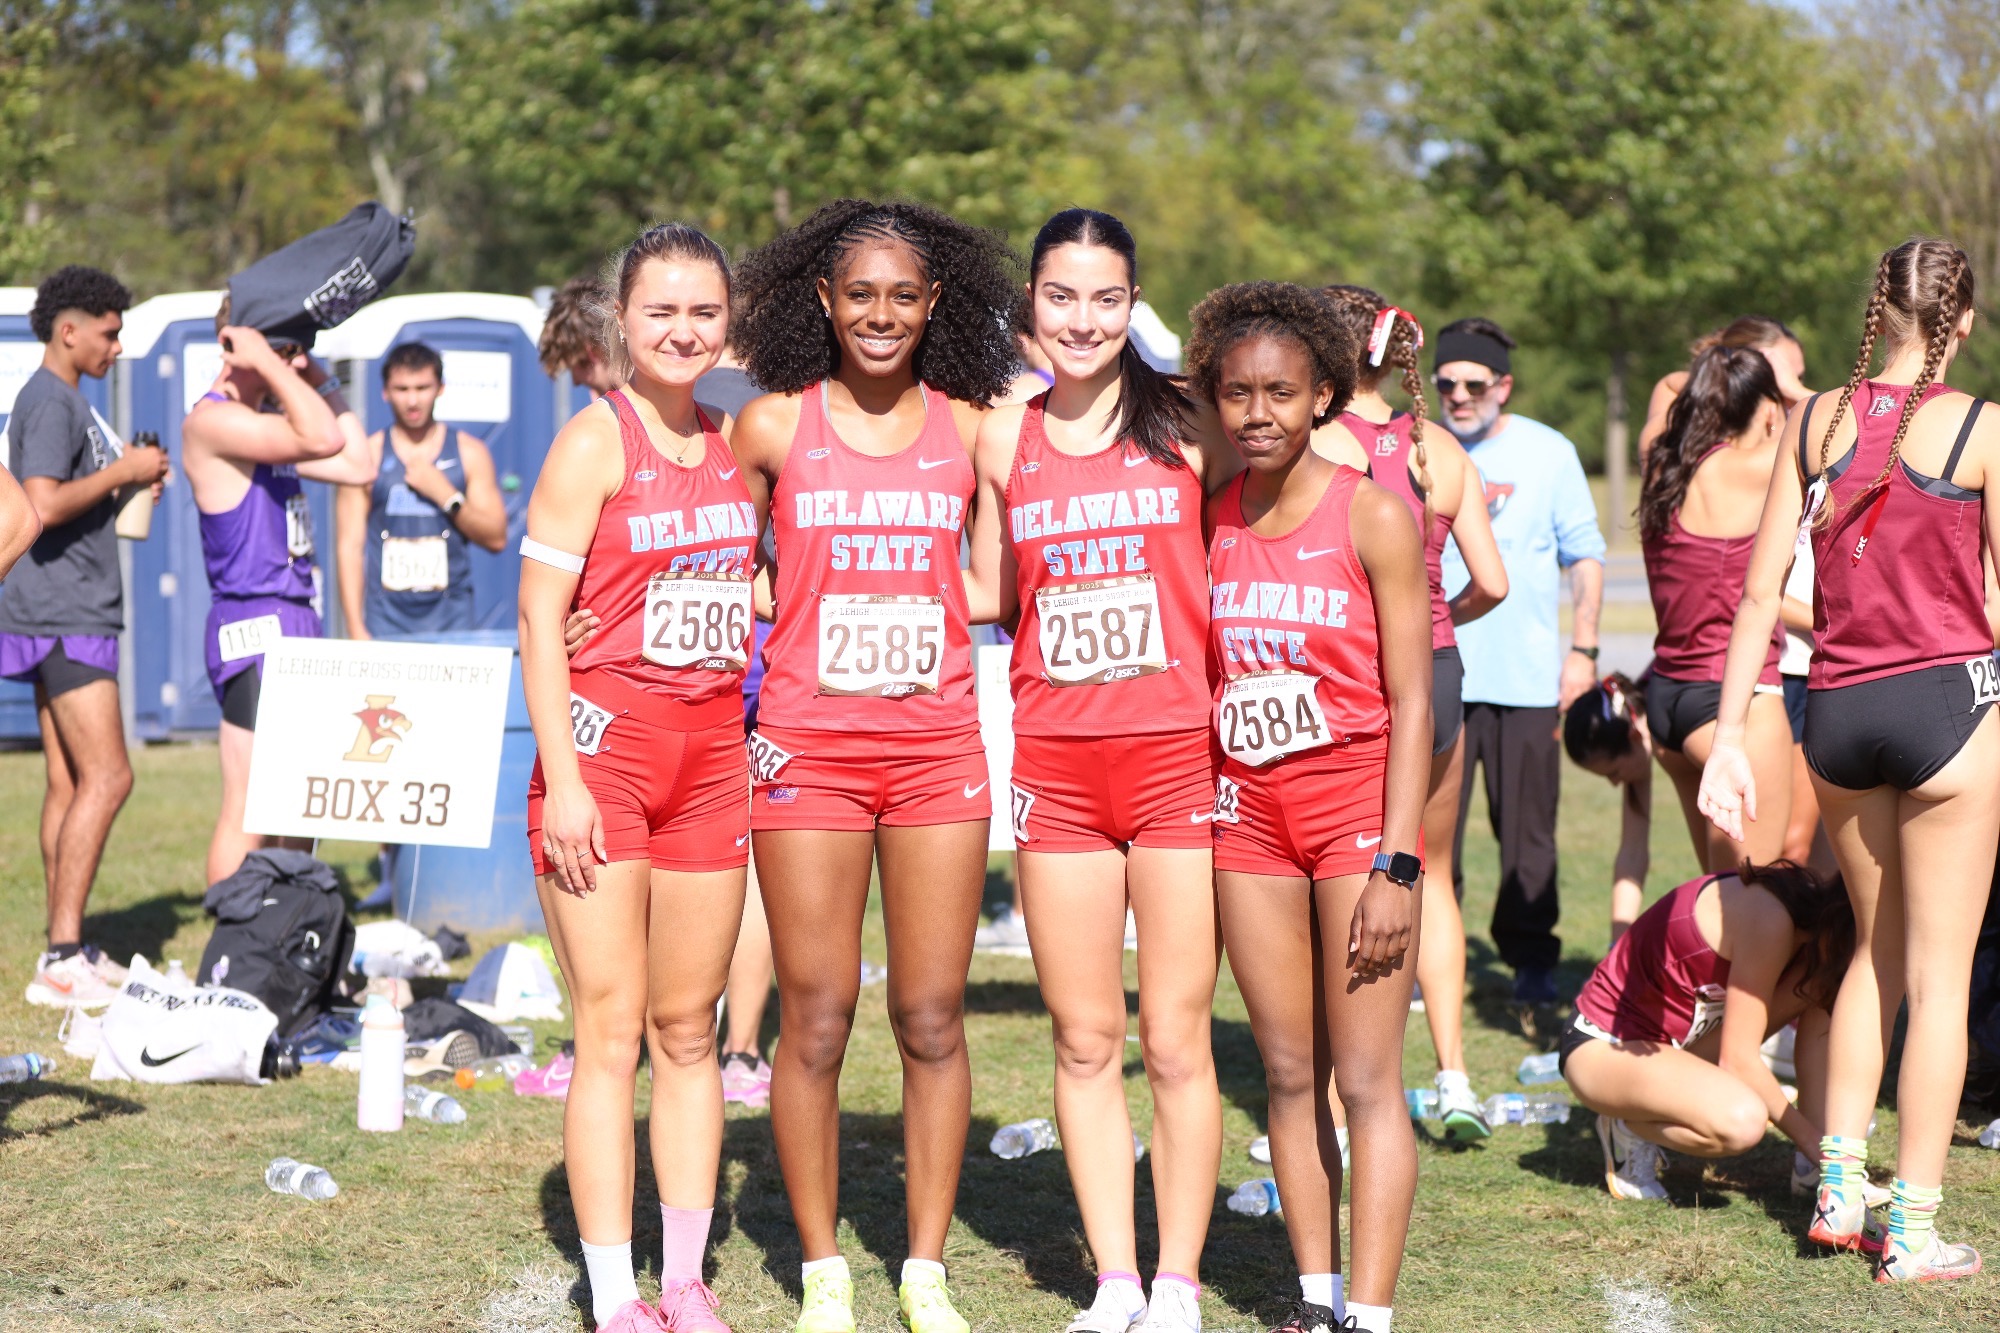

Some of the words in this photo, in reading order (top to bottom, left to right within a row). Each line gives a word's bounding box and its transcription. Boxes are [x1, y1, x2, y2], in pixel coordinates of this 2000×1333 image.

[809, 448, 830, 459] MEAC
[635, 471, 657, 480] MEAC
[796, 490, 962, 532] DELAWARE
[1011, 487, 1180, 543] DELAWARE
[627, 502, 758, 553] DELAWAR
[831, 535, 932, 571] STATE
[1043, 535, 1145, 576] STATE
[665, 583, 694, 592] LEHIGH
[1080, 582, 1100, 590] 2025
[840, 608, 870, 616] LEHIGH
[1053, 597, 1080, 608] LEHIGH
[651, 600, 746, 652] 2586
[1047, 603, 1153, 668] 2587
[826, 624, 938, 675] 2585
[1223, 627, 1308, 666] STATE
[278, 657, 343, 677] LEHIGH
[348, 660, 402, 680] CROSS
[407, 663, 494, 685] COUNTRY
[705, 660, 727, 668] asics
[1116, 666, 1140, 679] asics
[894, 683, 916, 694] asics
[1252, 680, 1270, 690] PAUL
[1223, 693, 1322, 752] 2584
[302, 776, 390, 823] BOX
[400, 781, 451, 827] 33
